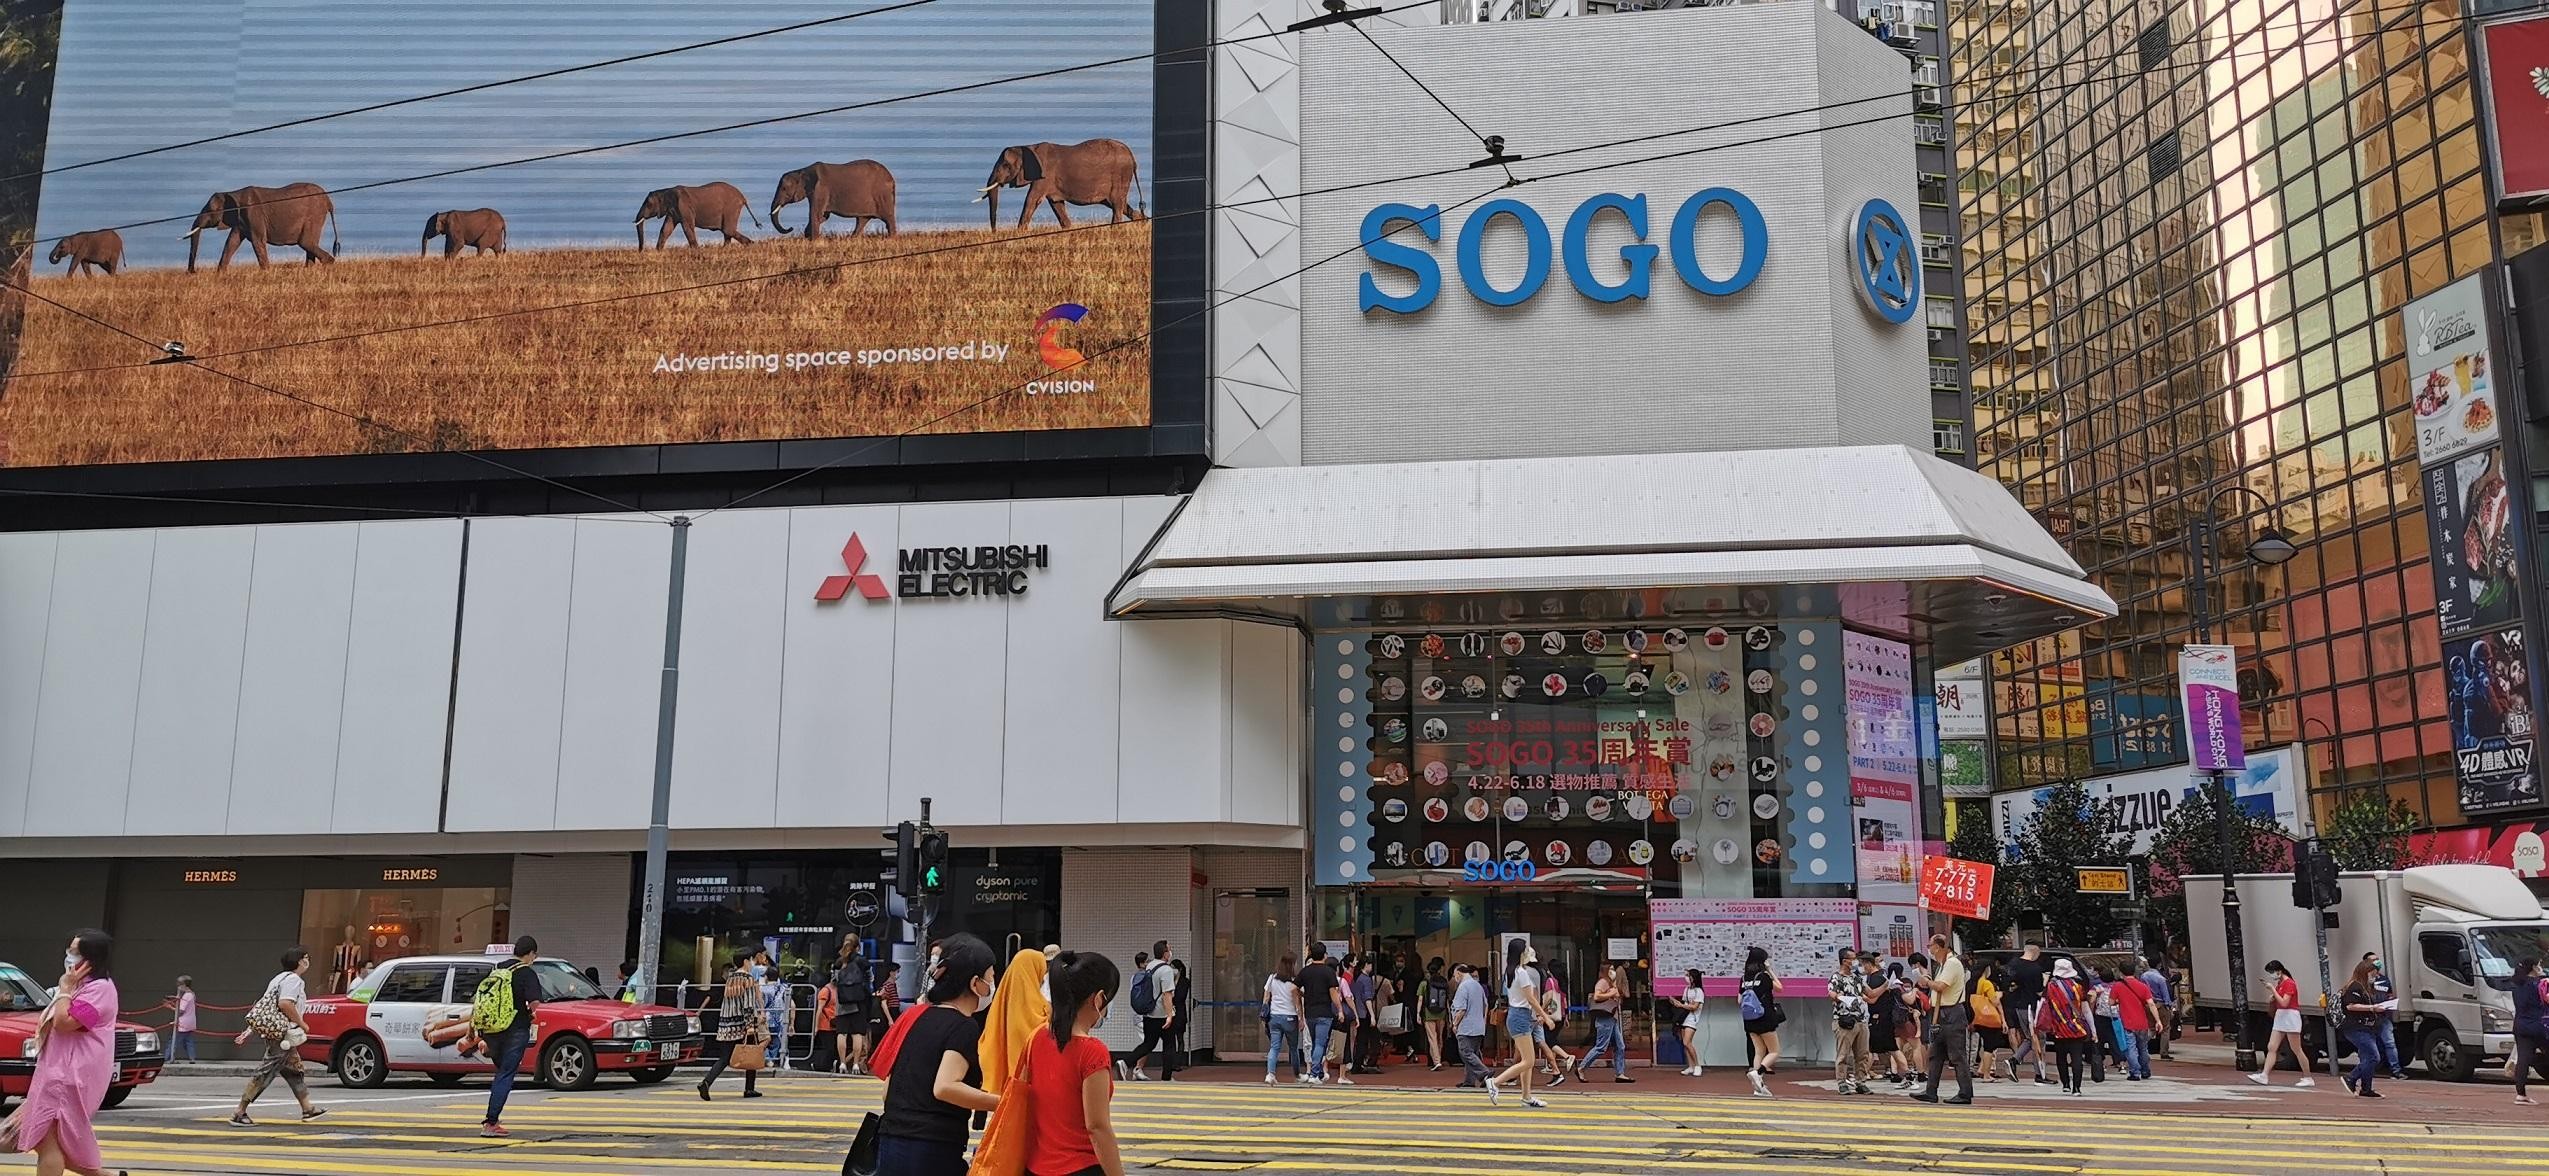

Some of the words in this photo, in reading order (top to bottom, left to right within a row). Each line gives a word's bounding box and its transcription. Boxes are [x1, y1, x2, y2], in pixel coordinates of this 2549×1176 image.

[1360, 187, 1769, 314] SOGO
[653, 350, 780, 374] Advertising
[785, 349, 851, 372] space
[857, 341, 978, 368] sponsored
[981, 340, 1009, 363] by
[1026, 380, 1096, 396] CVISION
[2423, 426, 2446, 447] 3/F
[899, 545, 1049, 573] MITSUBISHI
[898, 570, 1028, 598] ELECTRIC
[2438, 599, 2453, 614] 3F
[2501, 630, 2522, 646] VR
[1964, 665, 1979, 674] 6/F
[1850, 689, 1871, 703] SOGO
[2205, 691, 2214, 717] ASIA'S
[2211, 690, 2224, 728] HONG
[1466, 720, 1512, 734] SOGO
[1555, 718, 1650, 735] Anniversary
[1656, 718, 1690, 732] Sale
[2207, 718, 2217, 746] WORLD
[1466, 739, 1554, 767] SOGO
[1562, 737, 1692, 767] 35周年賞
[2211, 747, 2220, 767] CITY
[2216, 731, 2228, 768] KONG
[1853, 756, 1868, 769] PART
[1468, 775, 1545, 790] 4.22-6.18
[1550, 774, 1618, 791] 選物推薦
[1618, 790, 1669, 800] BOTEGA
[2001, 800, 2012, 838] izzue
[184, 870, 237, 882] HERMÈS
[383, 868, 438, 881] HERMÈS
[1463, 859, 1536, 882] SOGO
[975, 875, 1011, 889] dyson
[1013, 877, 1039, 888] pure
[975, 891, 1029, 903] cryptomic
